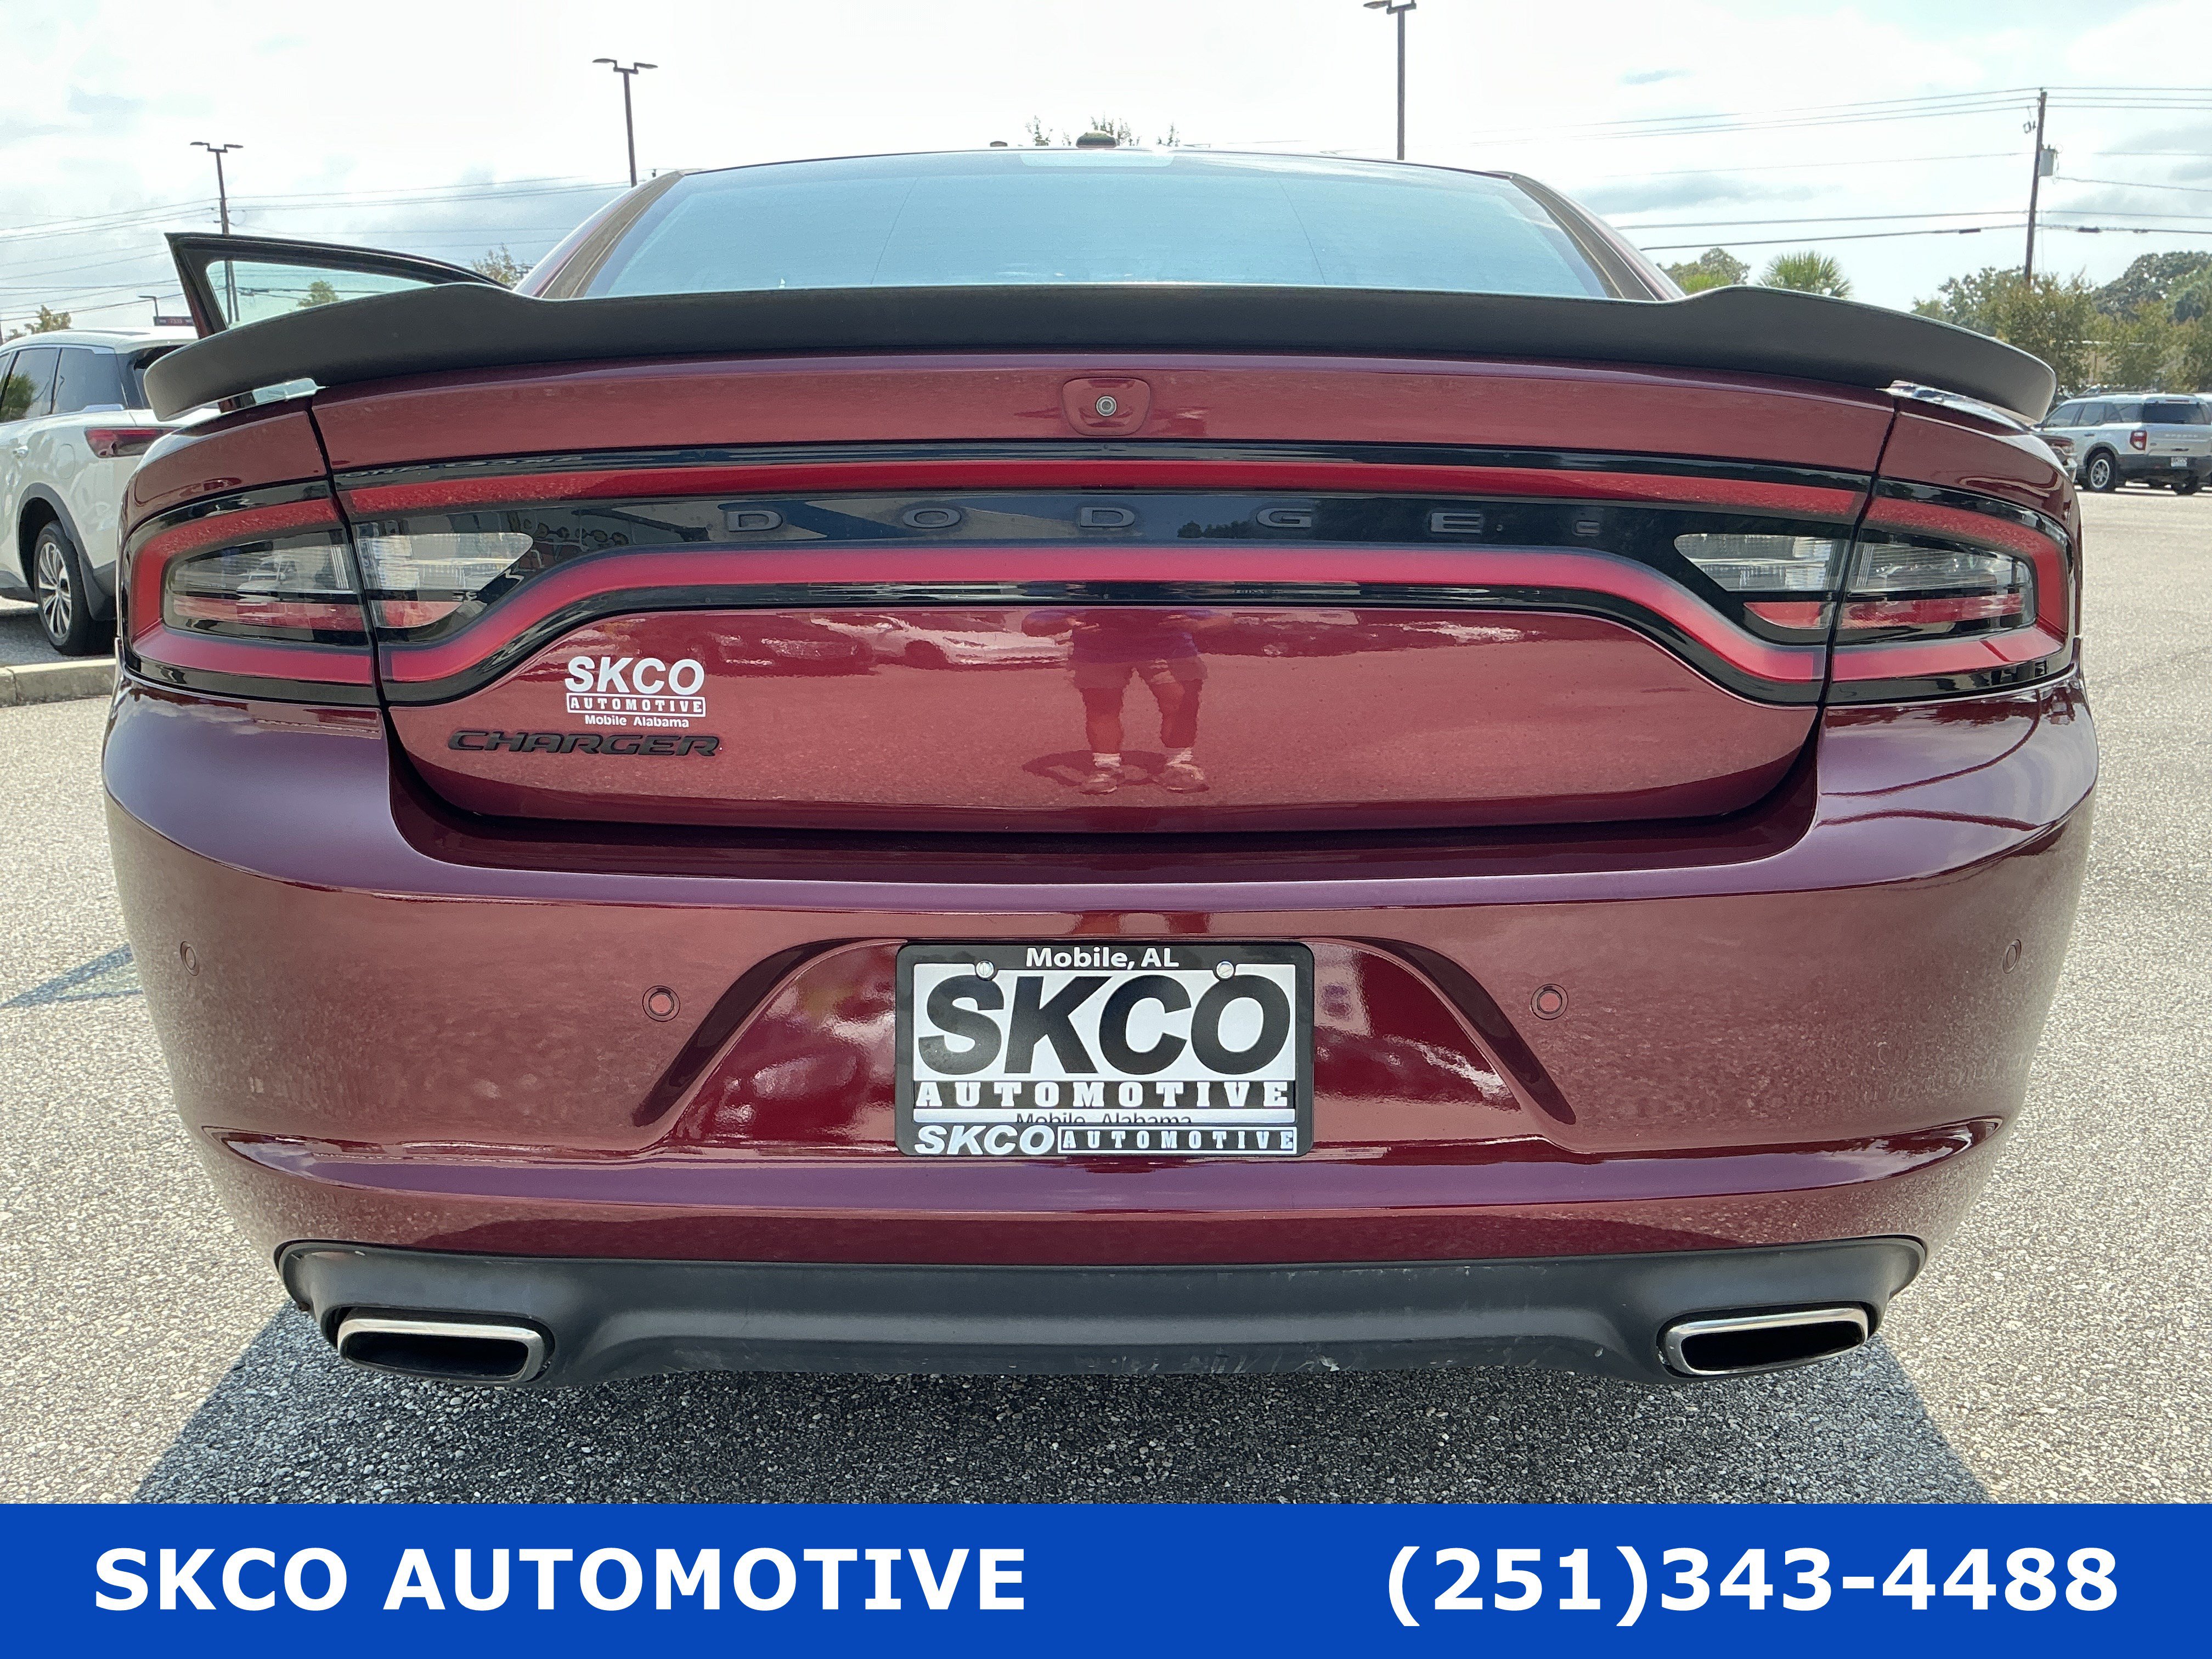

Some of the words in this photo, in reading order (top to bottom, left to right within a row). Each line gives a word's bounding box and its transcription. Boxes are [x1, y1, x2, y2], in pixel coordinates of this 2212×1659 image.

[727, 506, 1482, 534] DODGE
[565, 656, 705, 695] SKCO
[571, 697, 702, 713] AUTOMOTIVE
[585, 715, 627, 725] Mobile
[633, 716, 689, 727] Alabama
[448, 730, 720, 757] CHARGER
[1026, 946, 1135, 970] Mobile,
[1141, 947, 1180, 967] AL
[918, 974, 1291, 1075] SKCO
[916, 1081, 1289, 1107] AUTOMOTIVE
[914, 1125, 1056, 1155] SKCO
[1062, 1130, 1294, 1150] AUTOMOTIVE
